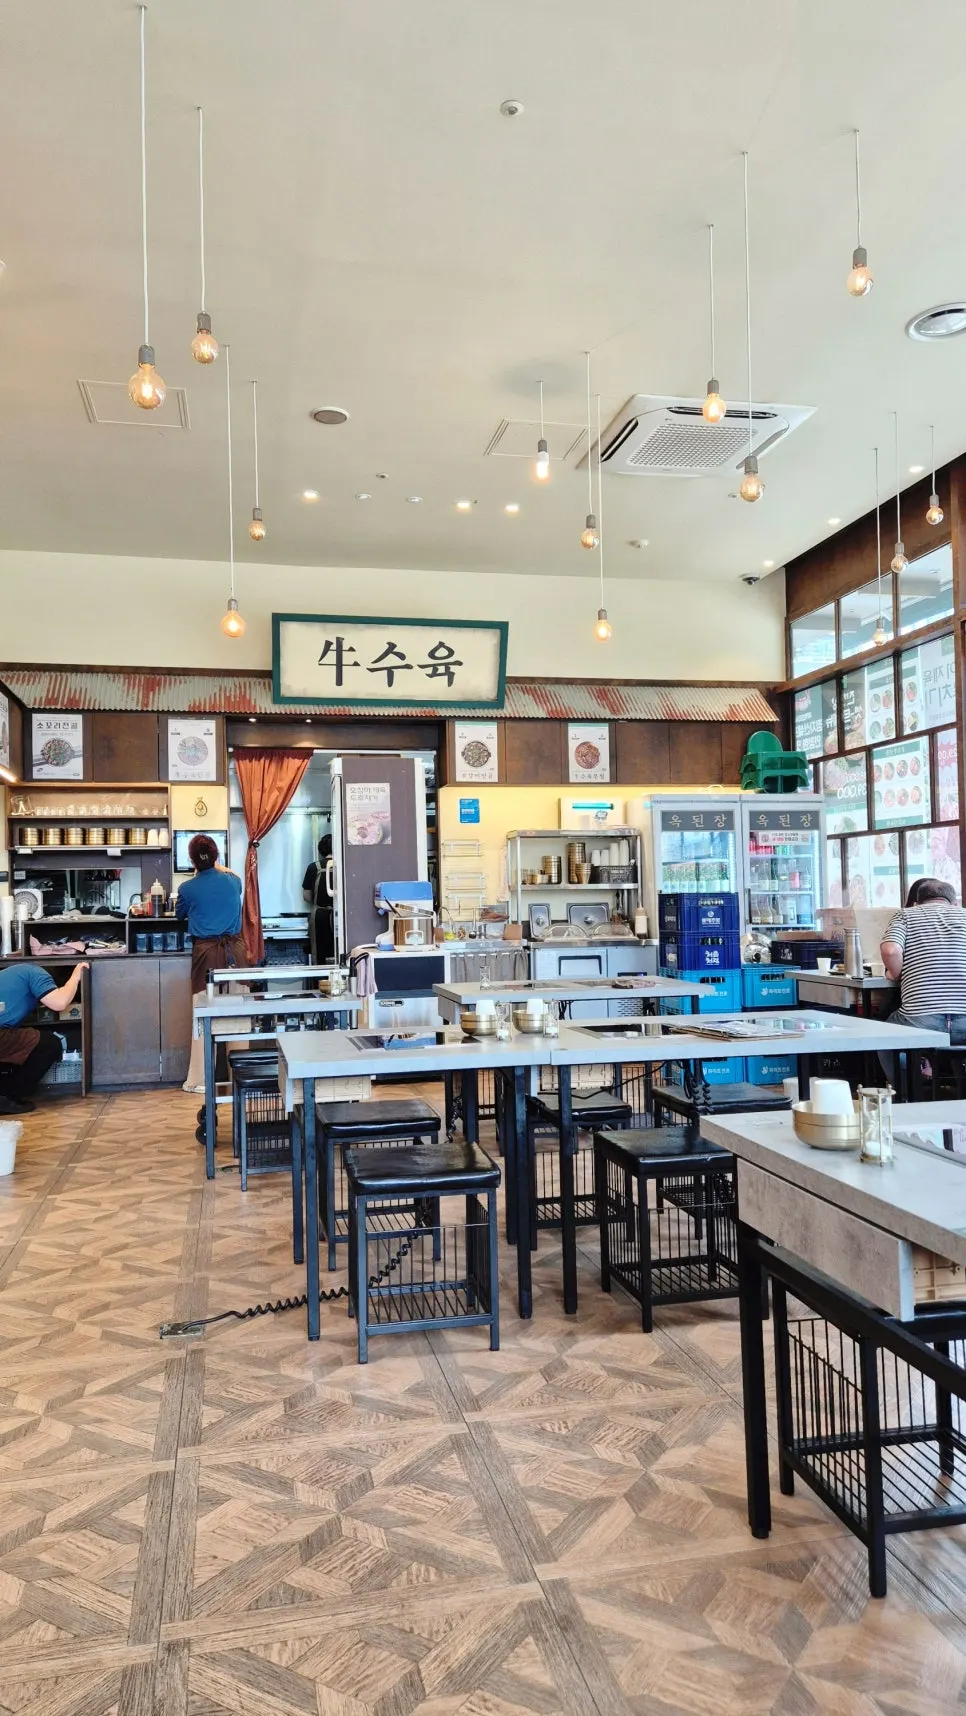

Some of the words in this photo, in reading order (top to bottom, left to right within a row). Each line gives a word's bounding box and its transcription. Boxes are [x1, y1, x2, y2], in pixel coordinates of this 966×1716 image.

[318, 636, 463, 688] 牛수육
[669, 813, 727, 828] 옥된장
[757, 813, 813, 828] 옥된장
